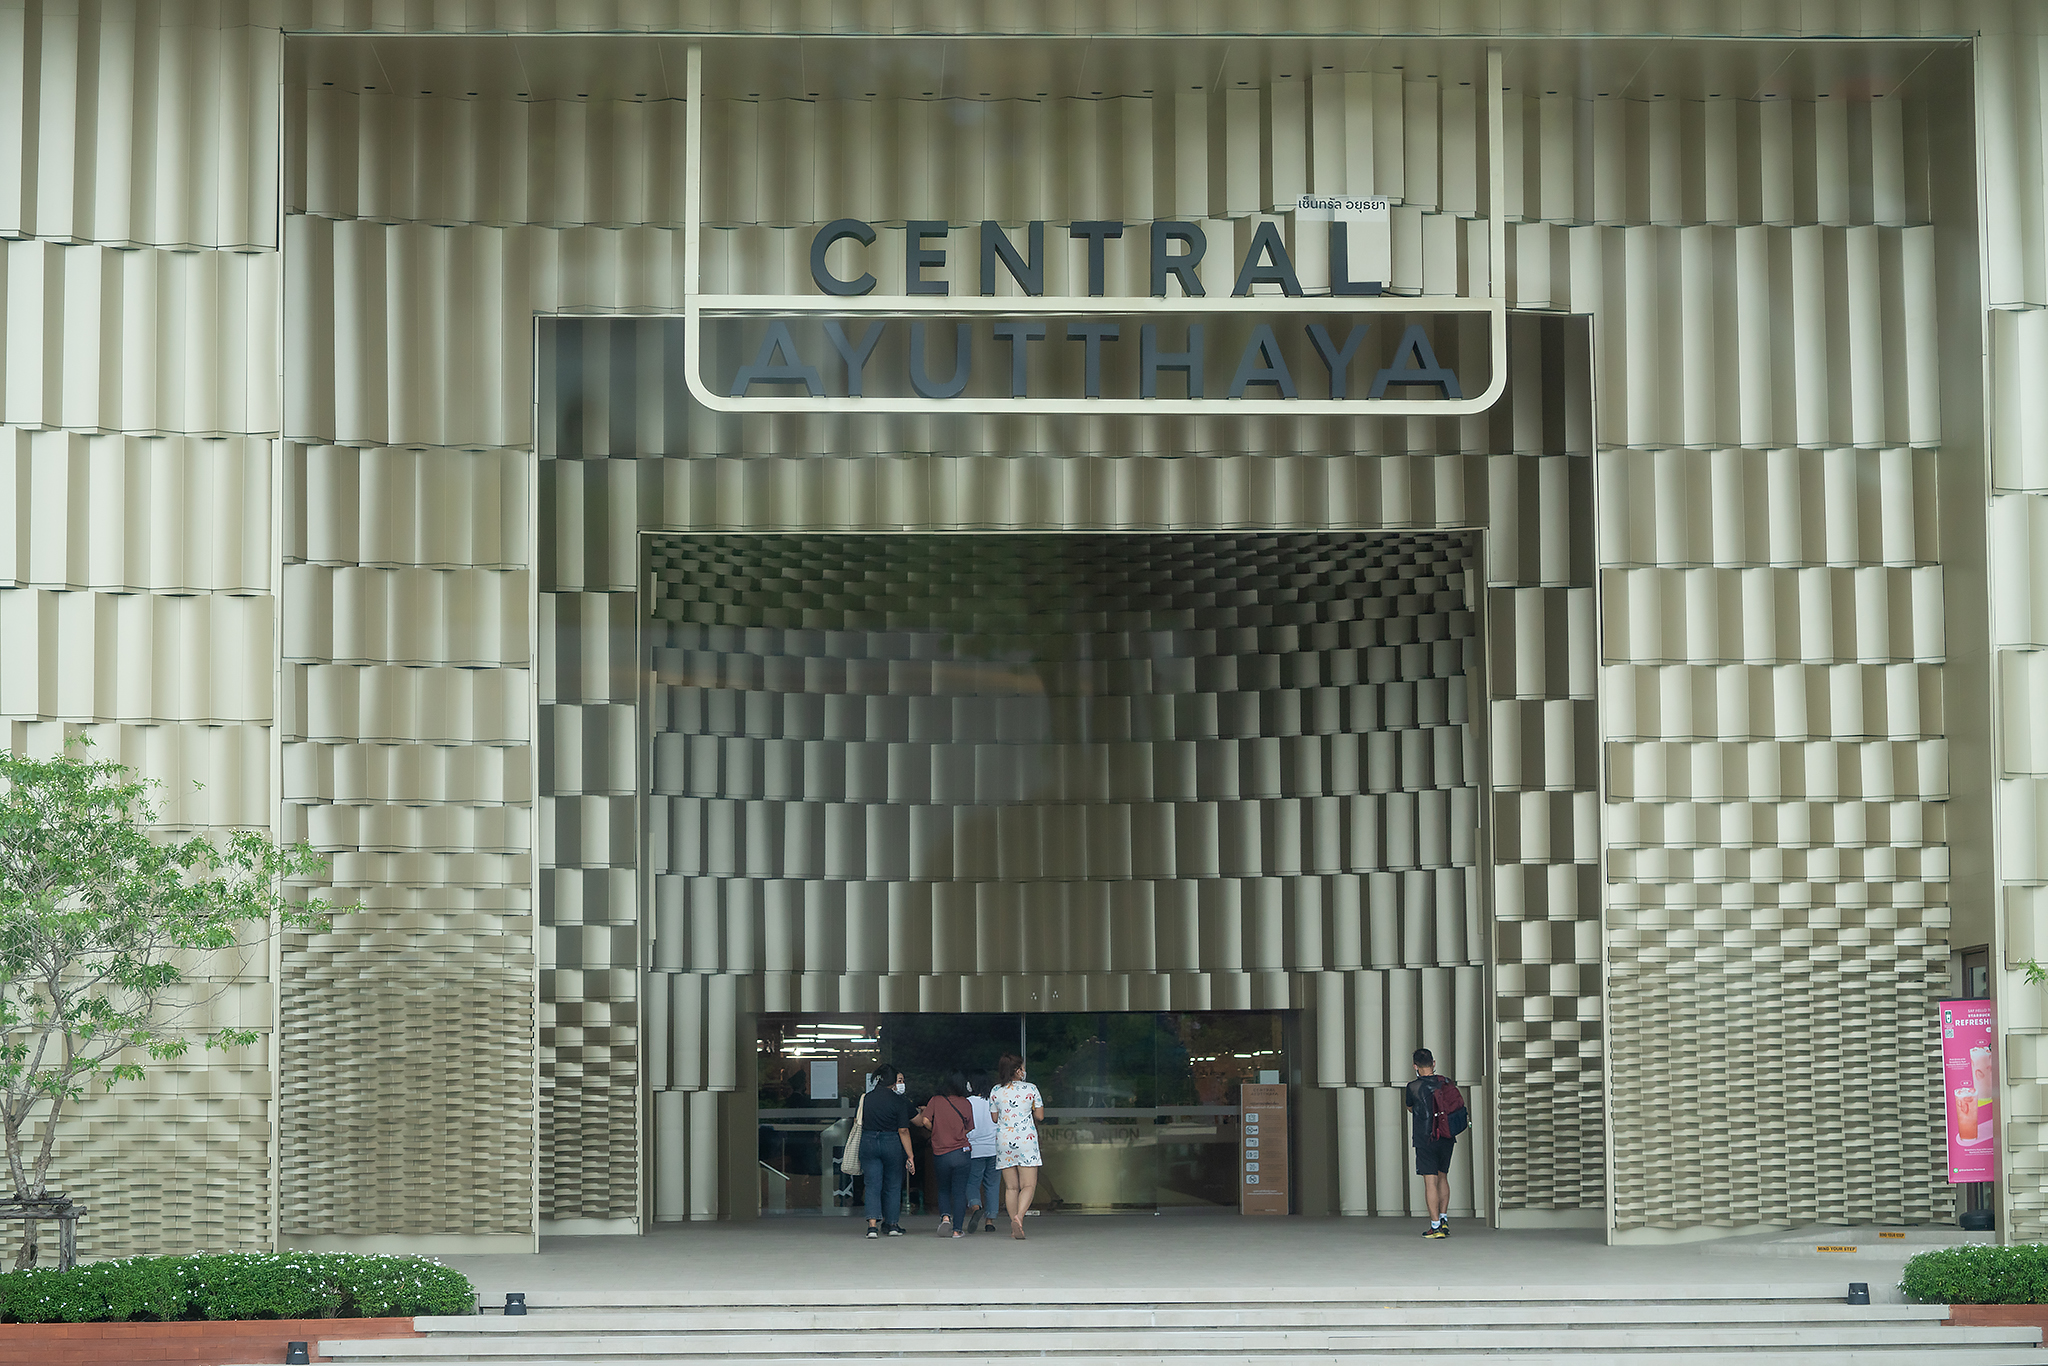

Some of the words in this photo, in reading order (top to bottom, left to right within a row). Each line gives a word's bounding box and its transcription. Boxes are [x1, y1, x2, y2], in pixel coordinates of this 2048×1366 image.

[1298, 195, 1342, 210] เซ็นทรัล
[1345, 200, 1386, 213] อยุธยา
[809, 218, 1383, 298] CENTRAL
[729, 321, 1463, 400] AYUTTHAYA
[1955, 1018, 1991, 1027] REFRESH
[1041, 1127, 1140, 1142] INFOATION
